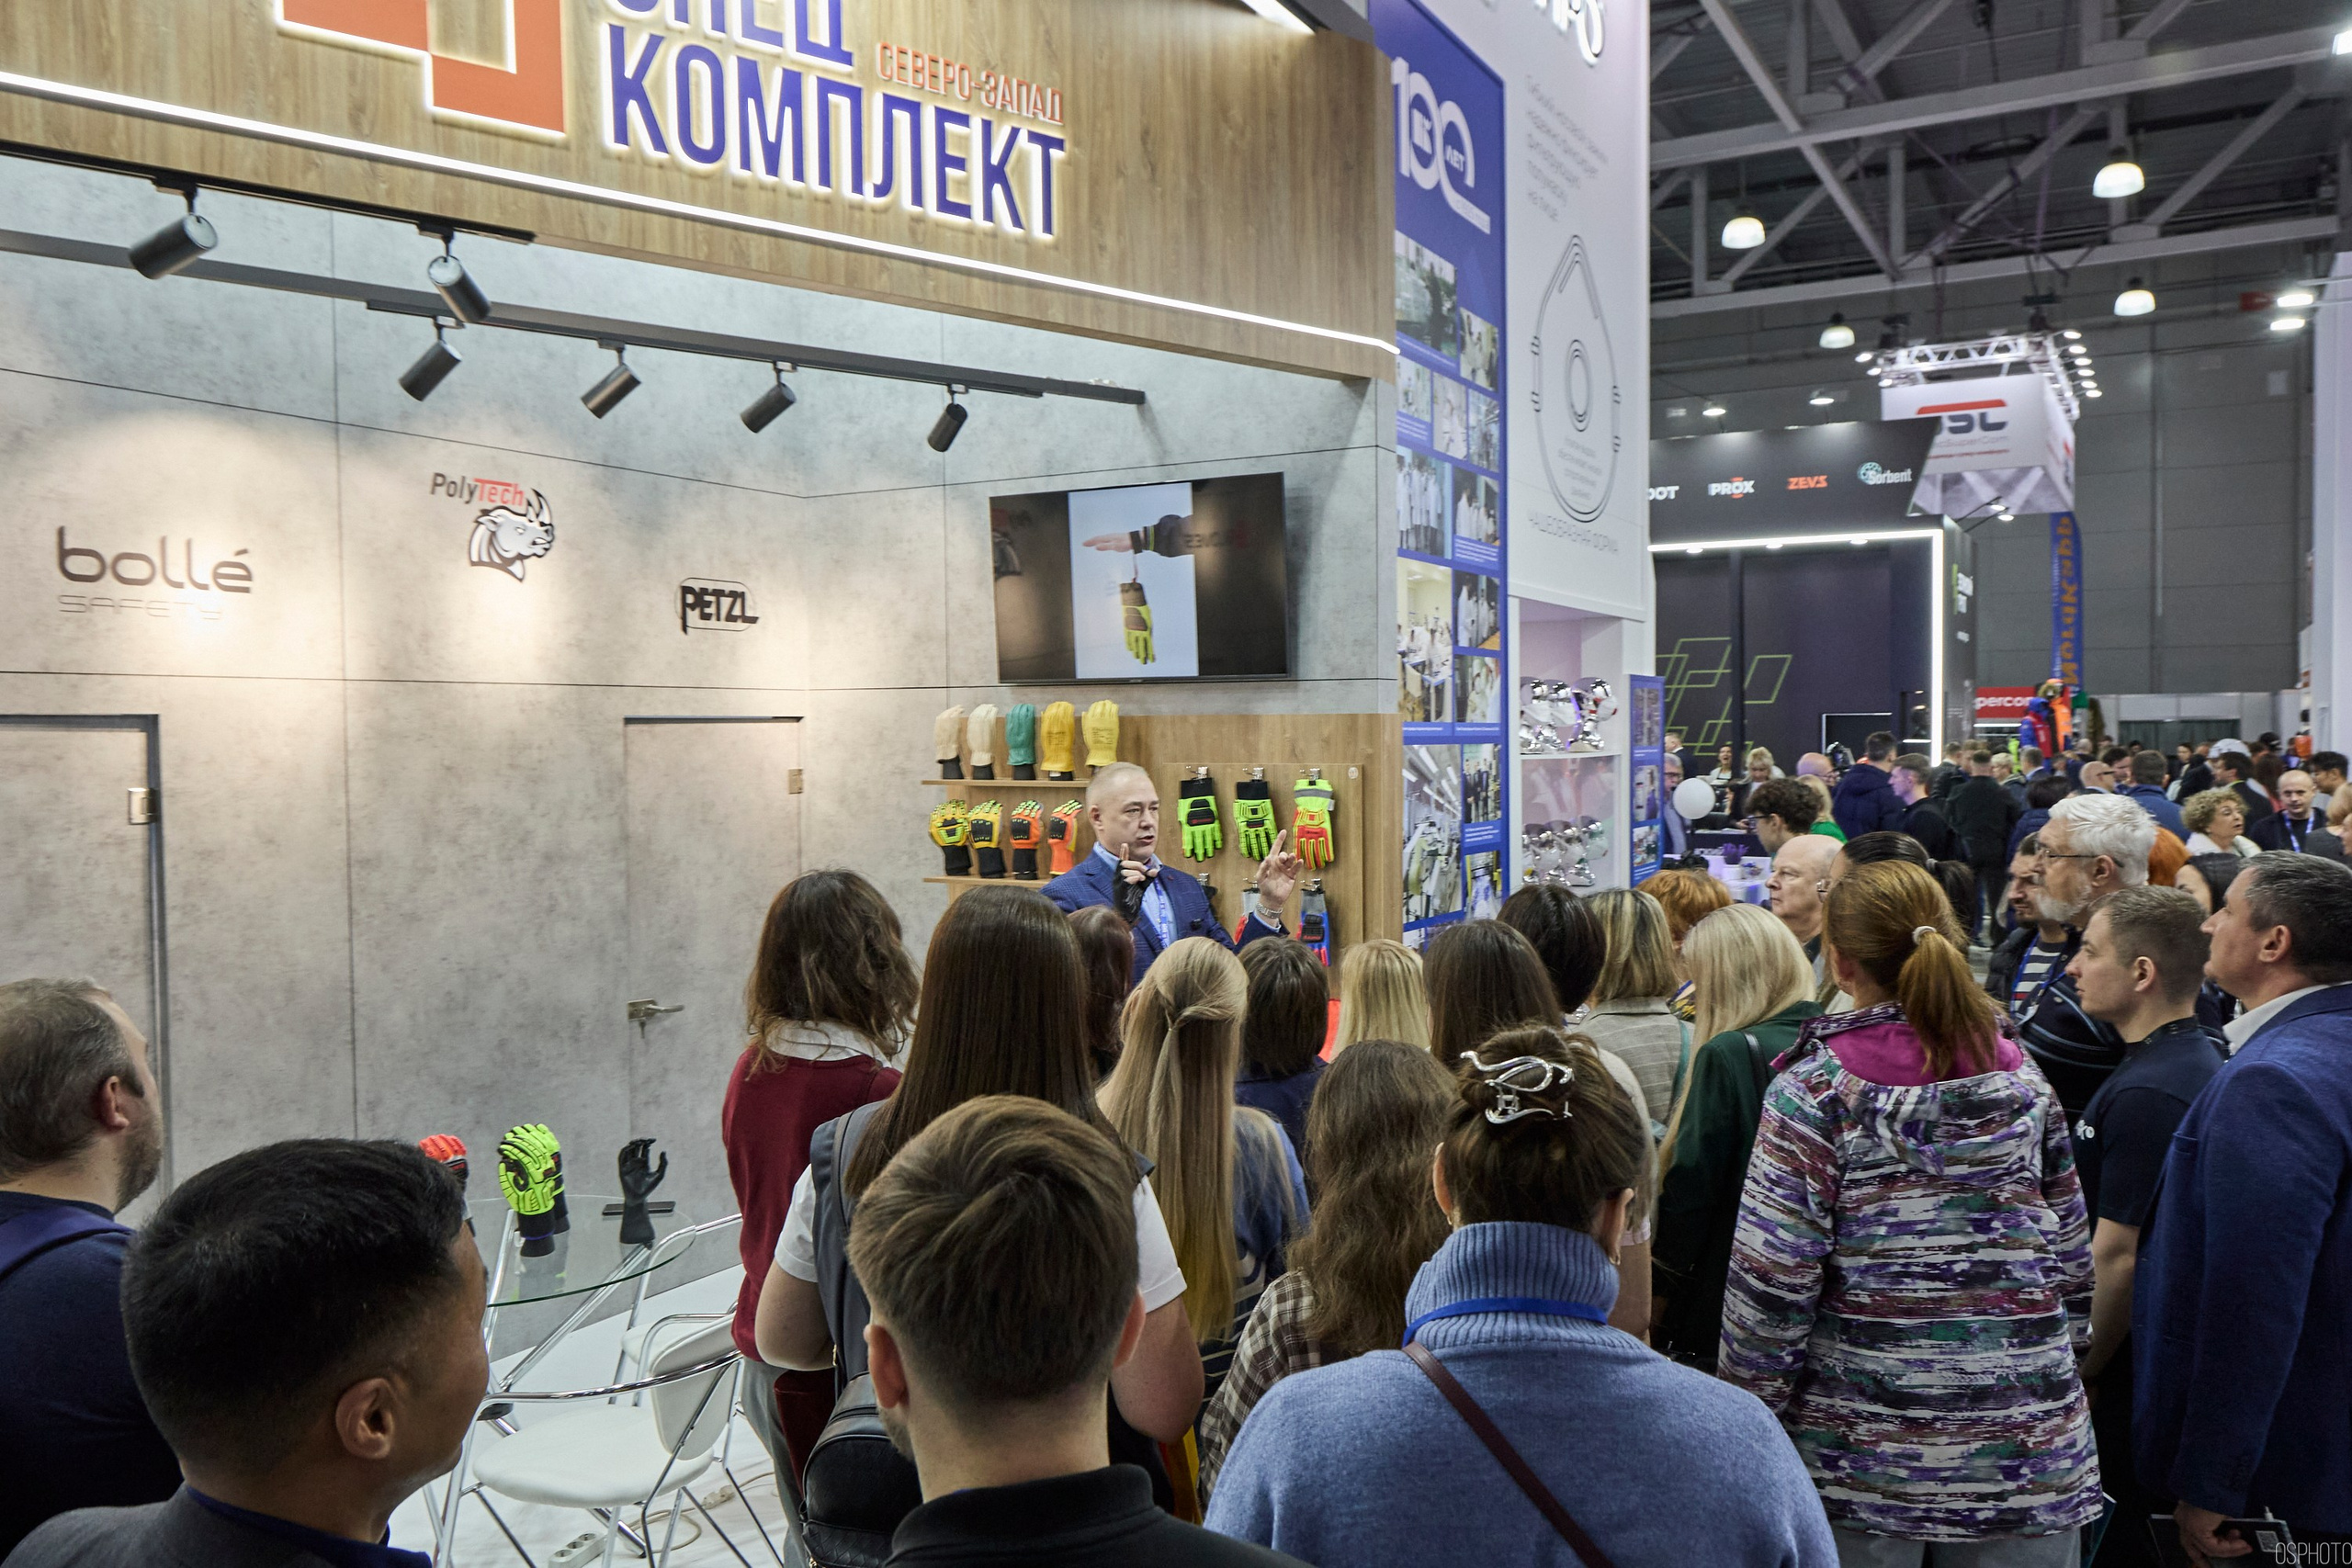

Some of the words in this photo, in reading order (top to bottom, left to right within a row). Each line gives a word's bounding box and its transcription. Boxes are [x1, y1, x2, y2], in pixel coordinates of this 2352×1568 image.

[876, 41, 1065, 126] СЕВЕРО-ЗАПАД
[603, 24, 1066, 238] КОМПЛЕКТ
[430, 472, 526, 507] PolyTech
[1708, 479, 1755, 496] PROX
[1868, 468, 1913, 485] Sorbent
[57, 525, 254, 594] bollé
[681, 585, 760, 636] PETZL
